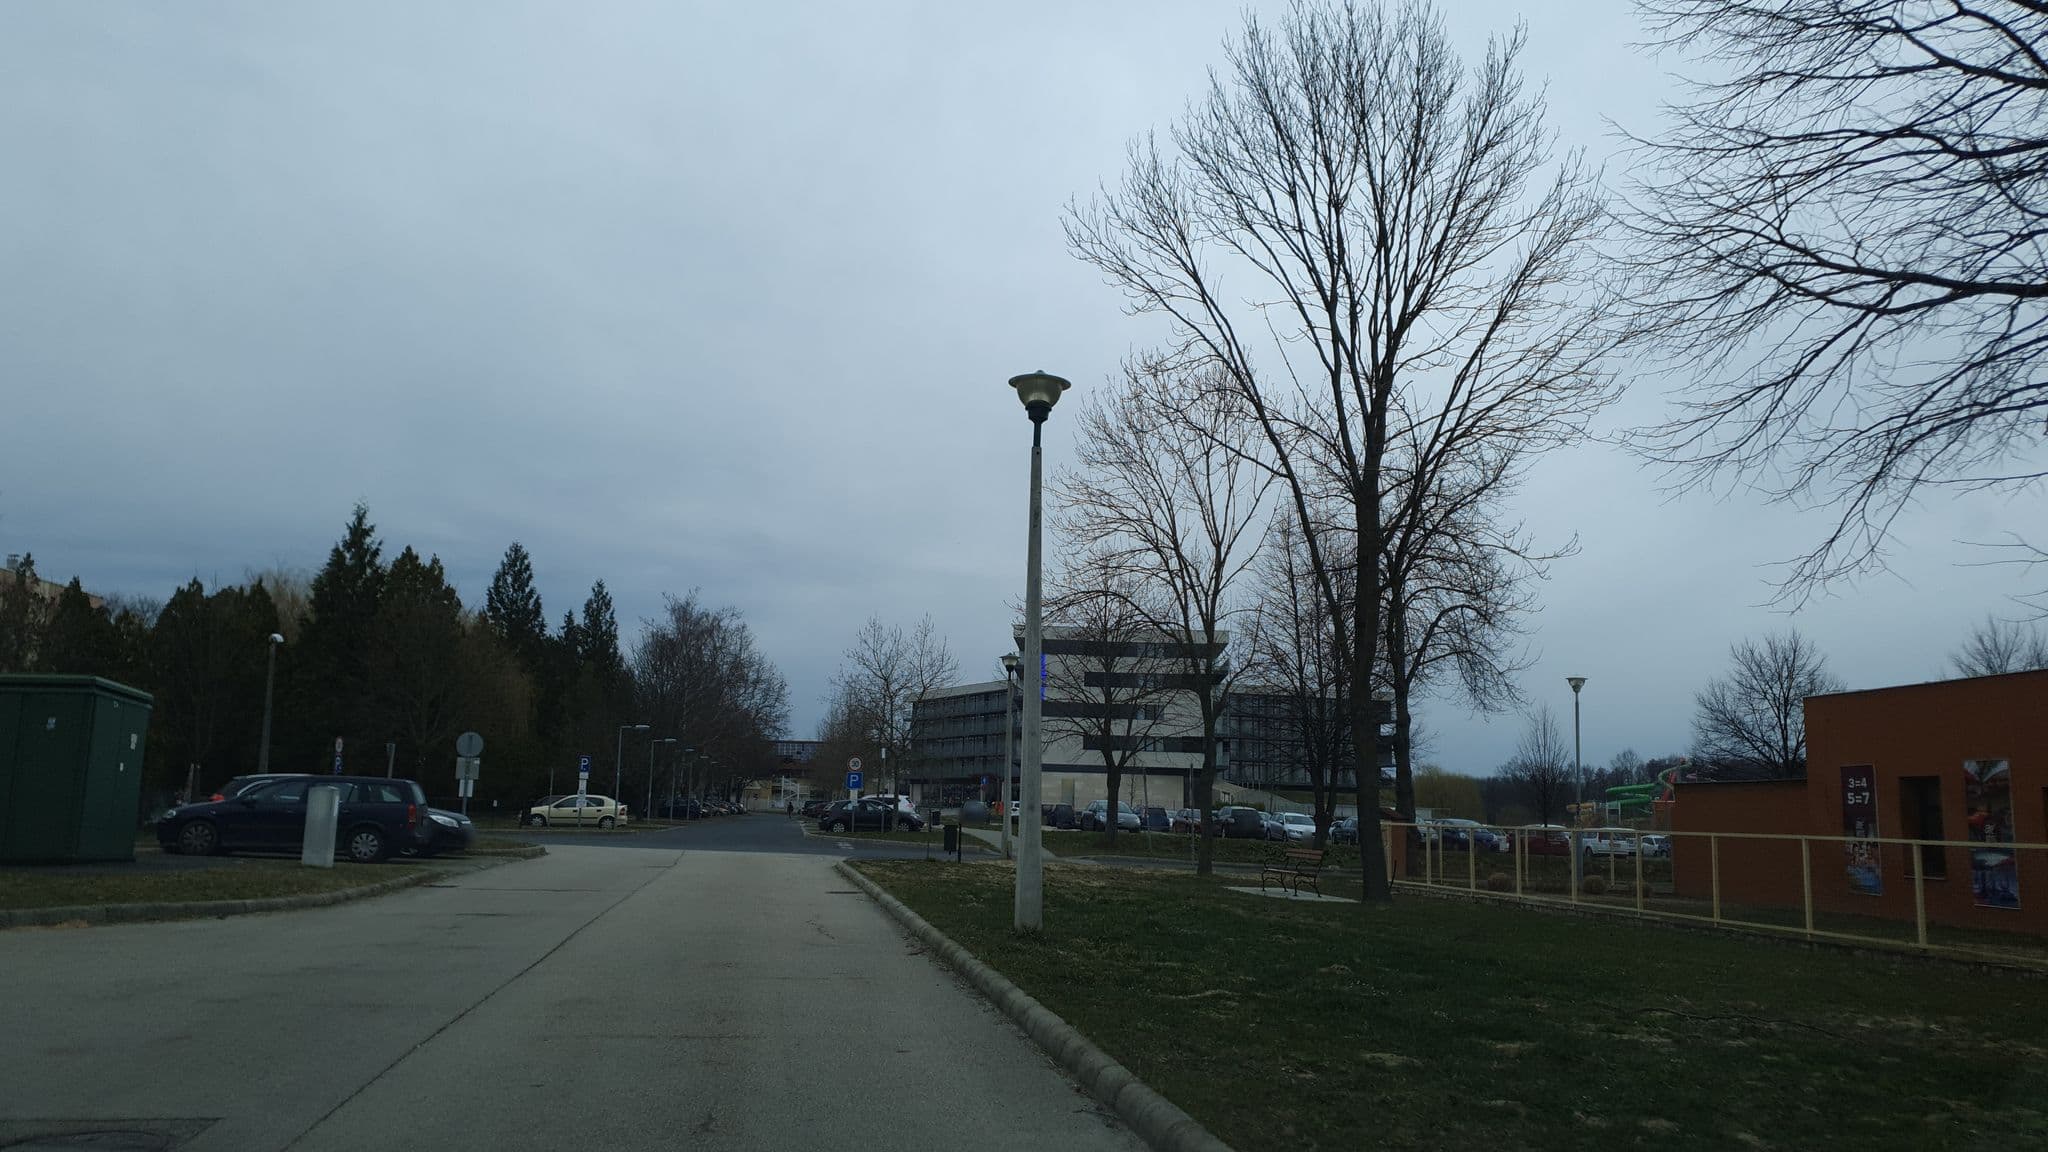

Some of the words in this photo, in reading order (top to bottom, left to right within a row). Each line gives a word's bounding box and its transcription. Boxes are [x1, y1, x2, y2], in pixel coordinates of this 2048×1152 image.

[849, 774, 859, 787] P
[1848, 777, 1867, 789] 3=4
[1847, 792, 1870, 805] 5=7
